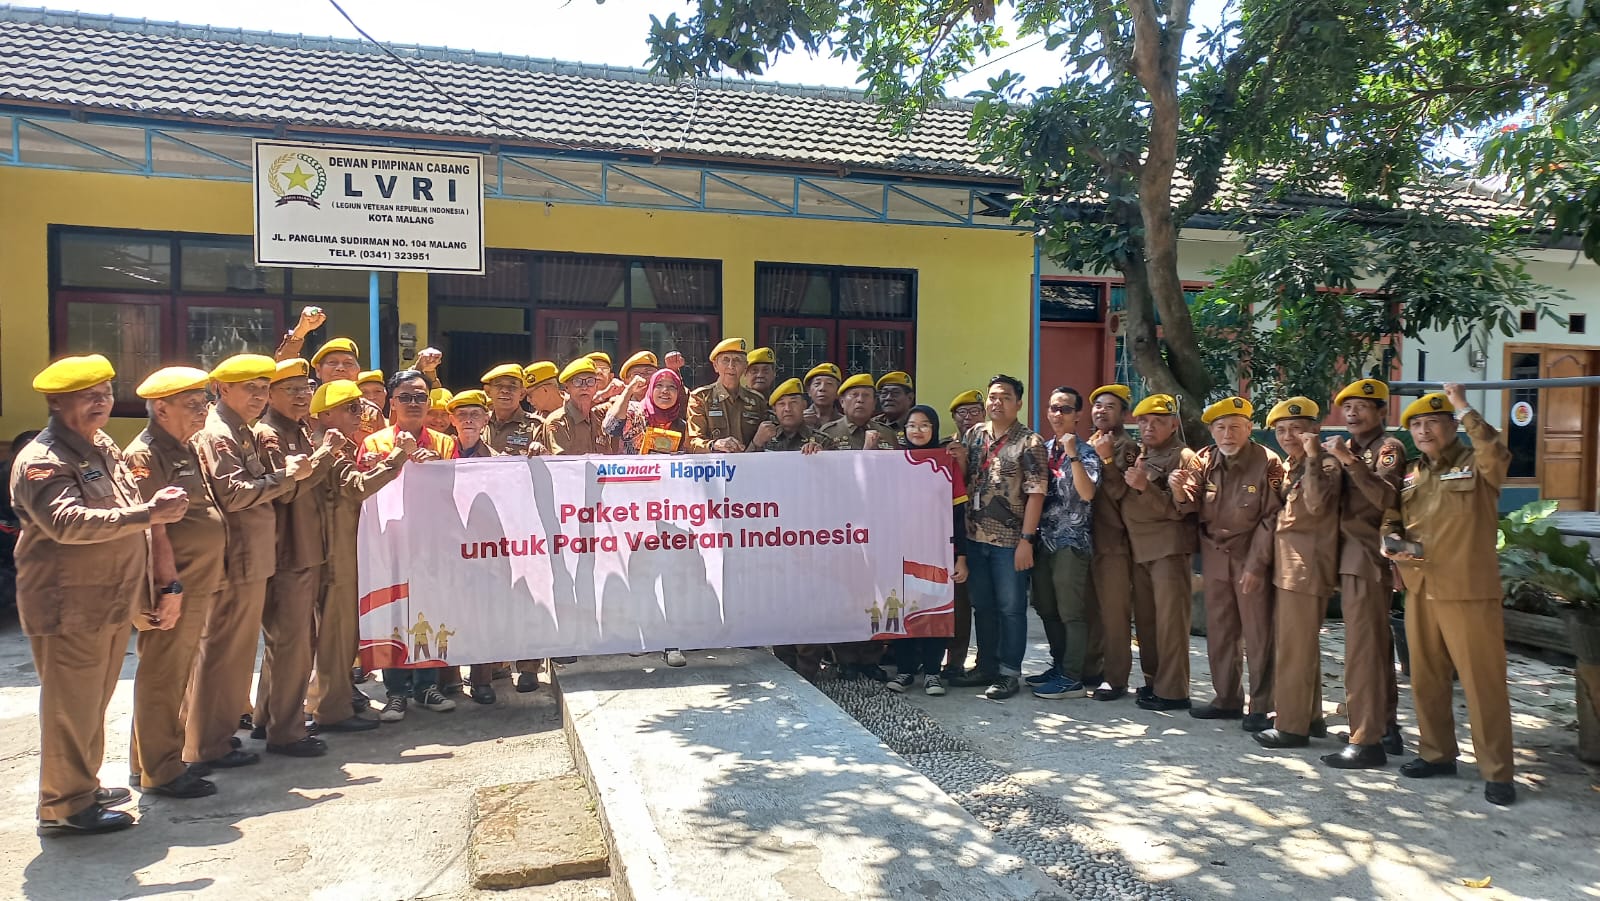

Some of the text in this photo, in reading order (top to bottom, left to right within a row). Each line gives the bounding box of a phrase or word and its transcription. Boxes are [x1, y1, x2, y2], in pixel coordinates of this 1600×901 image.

[329, 157, 470, 174] DEWAN PIMPINAN CABANG
[363, 203, 394, 211] VETERAN
[395, 205, 428, 213] REPUBLIK
[368, 214, 434, 224] KOTA MALANG
[289, 234, 338, 244] PANGLIMA
[340, 237, 390, 246] SUDIRMAN
[392, 239, 408, 247] NO.
[411, 240, 426, 248] 104
[429, 241, 467, 249] MALANG
[329, 249, 430, 260] TELP. (0341) 323951
[597, 460, 736, 482] Alfamart Happily
[561, 498, 779, 527] Paket Bingkisan
[461, 523, 869, 559] untuk Para Veteran Indonesia
